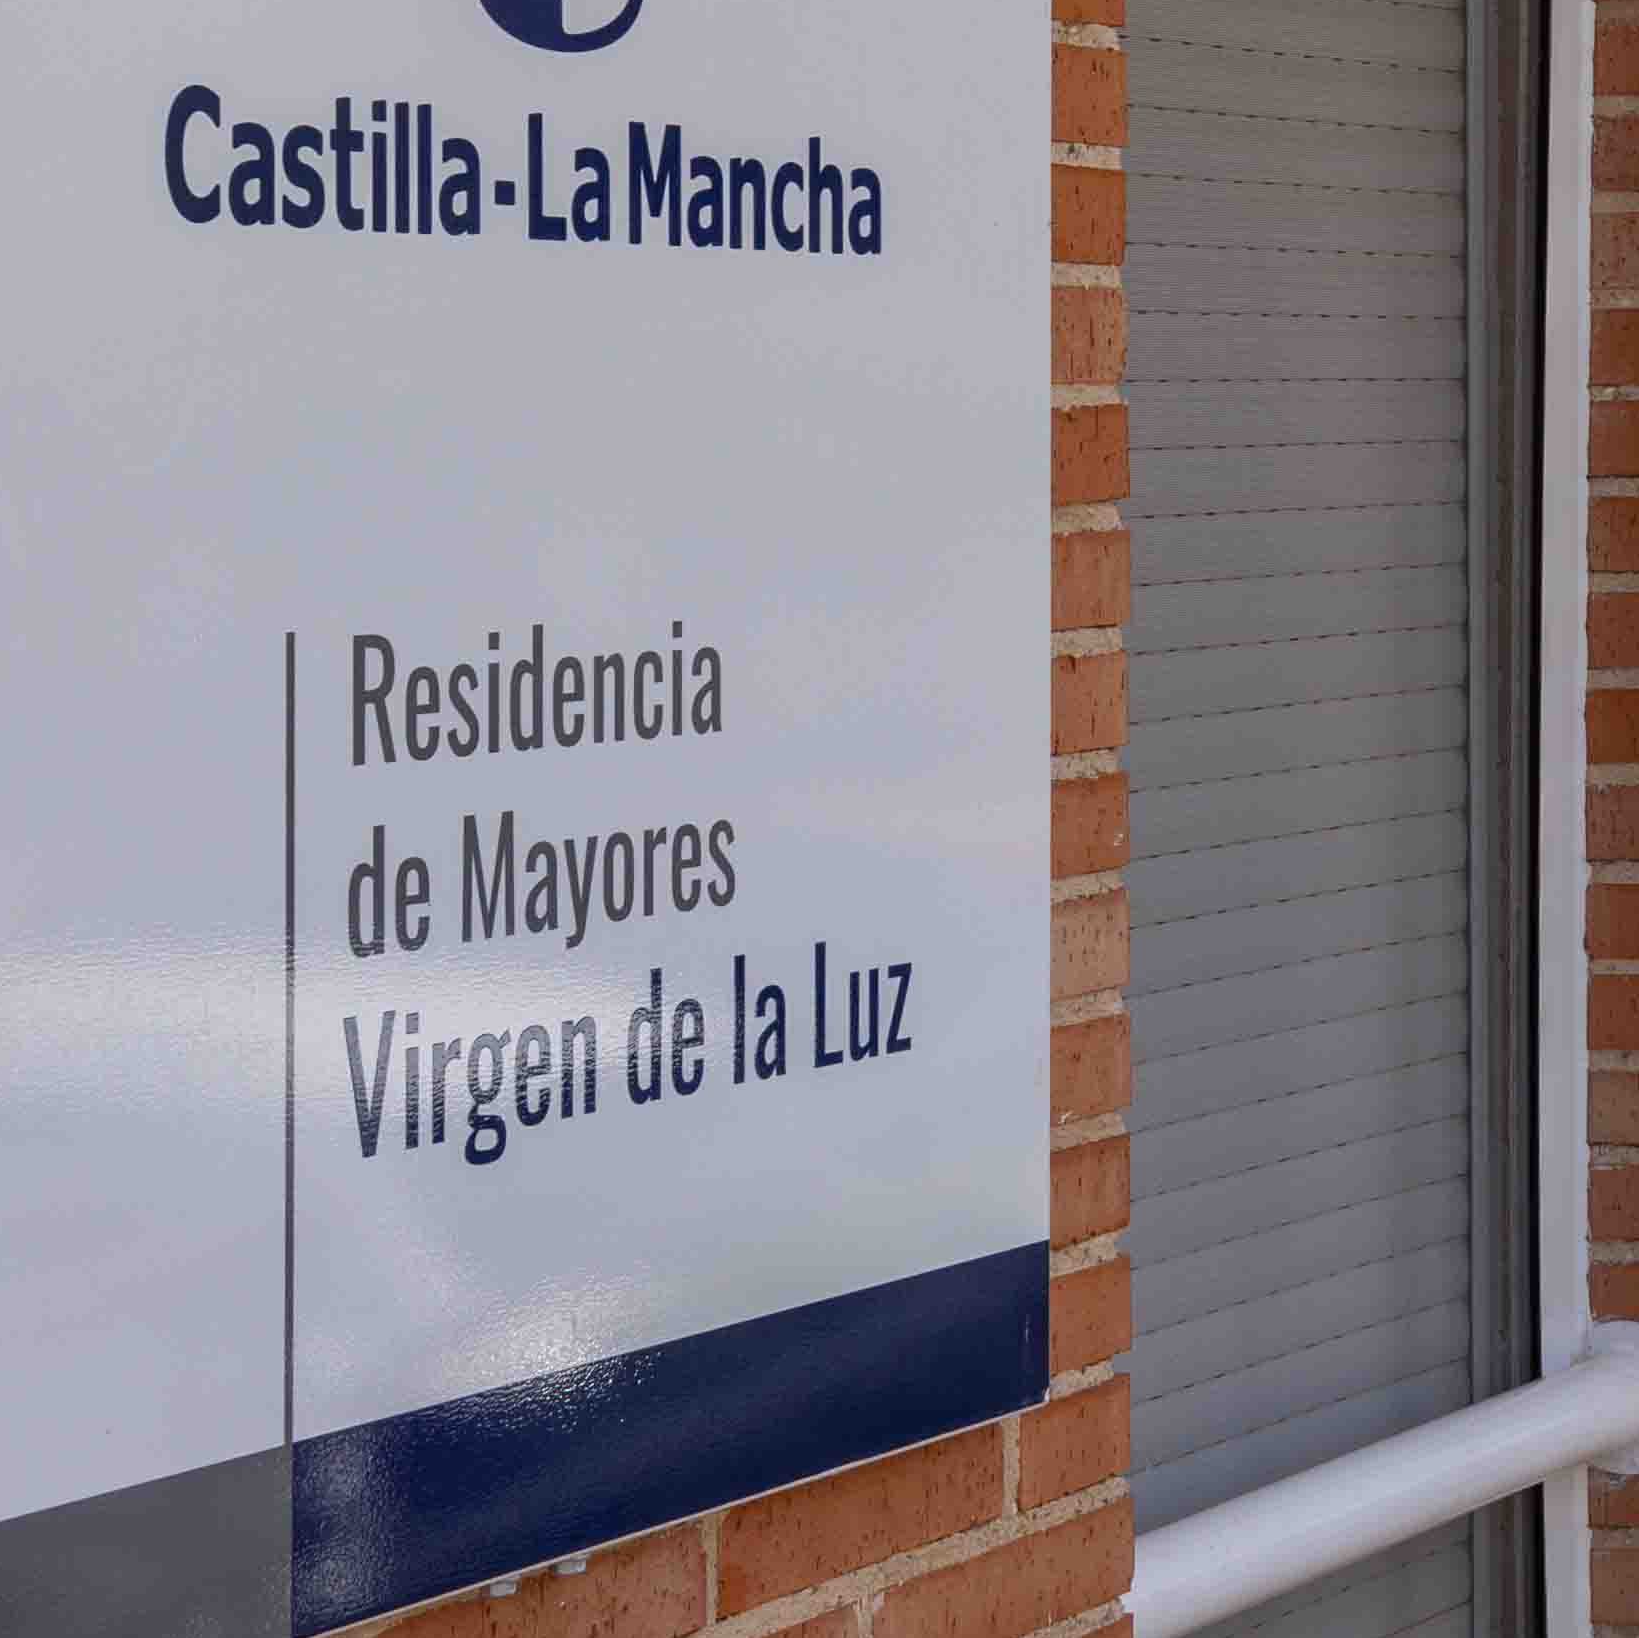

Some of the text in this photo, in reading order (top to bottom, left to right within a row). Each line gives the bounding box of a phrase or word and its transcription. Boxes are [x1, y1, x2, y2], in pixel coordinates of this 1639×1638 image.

[628, 121, 882, 256] Mancha
[352, 620, 723, 767] Residencia
[347, 809, 736, 959] de Mayores
[343, 940, 913, 1166] Virgen de la Luz
